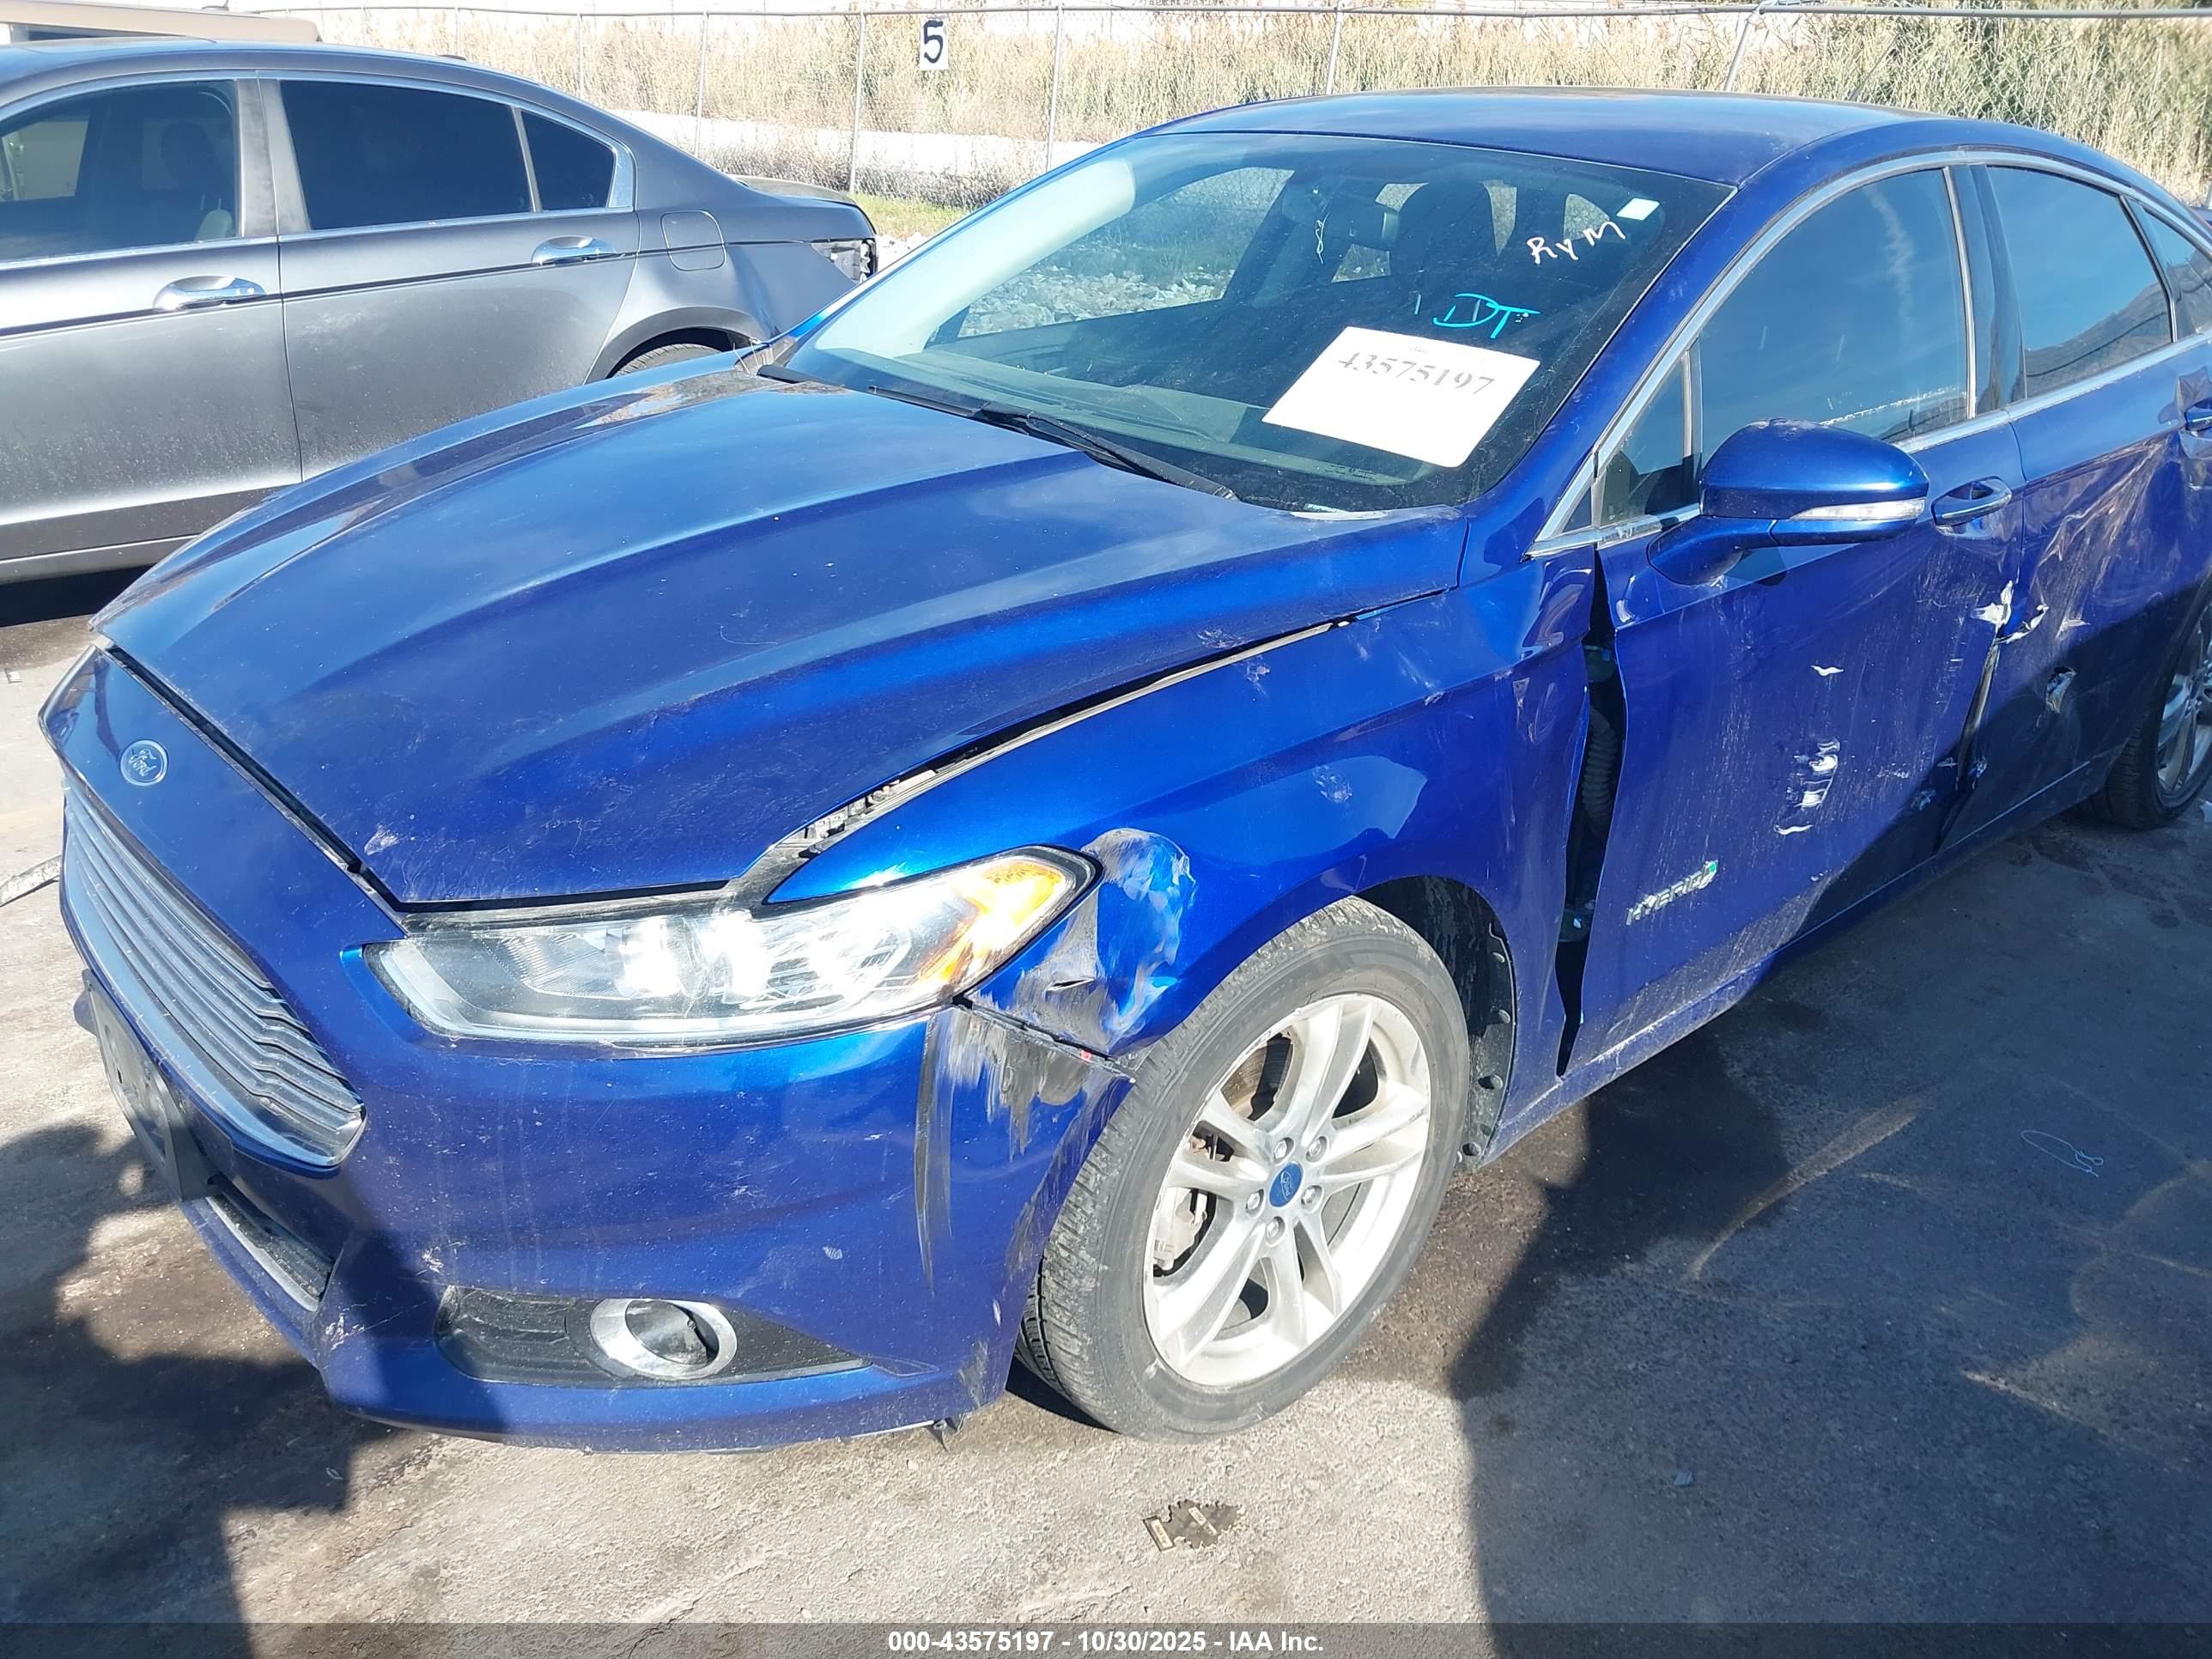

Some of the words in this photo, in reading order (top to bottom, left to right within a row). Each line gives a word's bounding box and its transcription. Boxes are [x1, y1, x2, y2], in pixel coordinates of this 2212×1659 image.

[923, 20, 944, 64] 5
[1432, 292, 1540, 339] DT
[1338, 351, 1496, 395] 43575197
[1626, 867, 1706, 926] HYBRID
